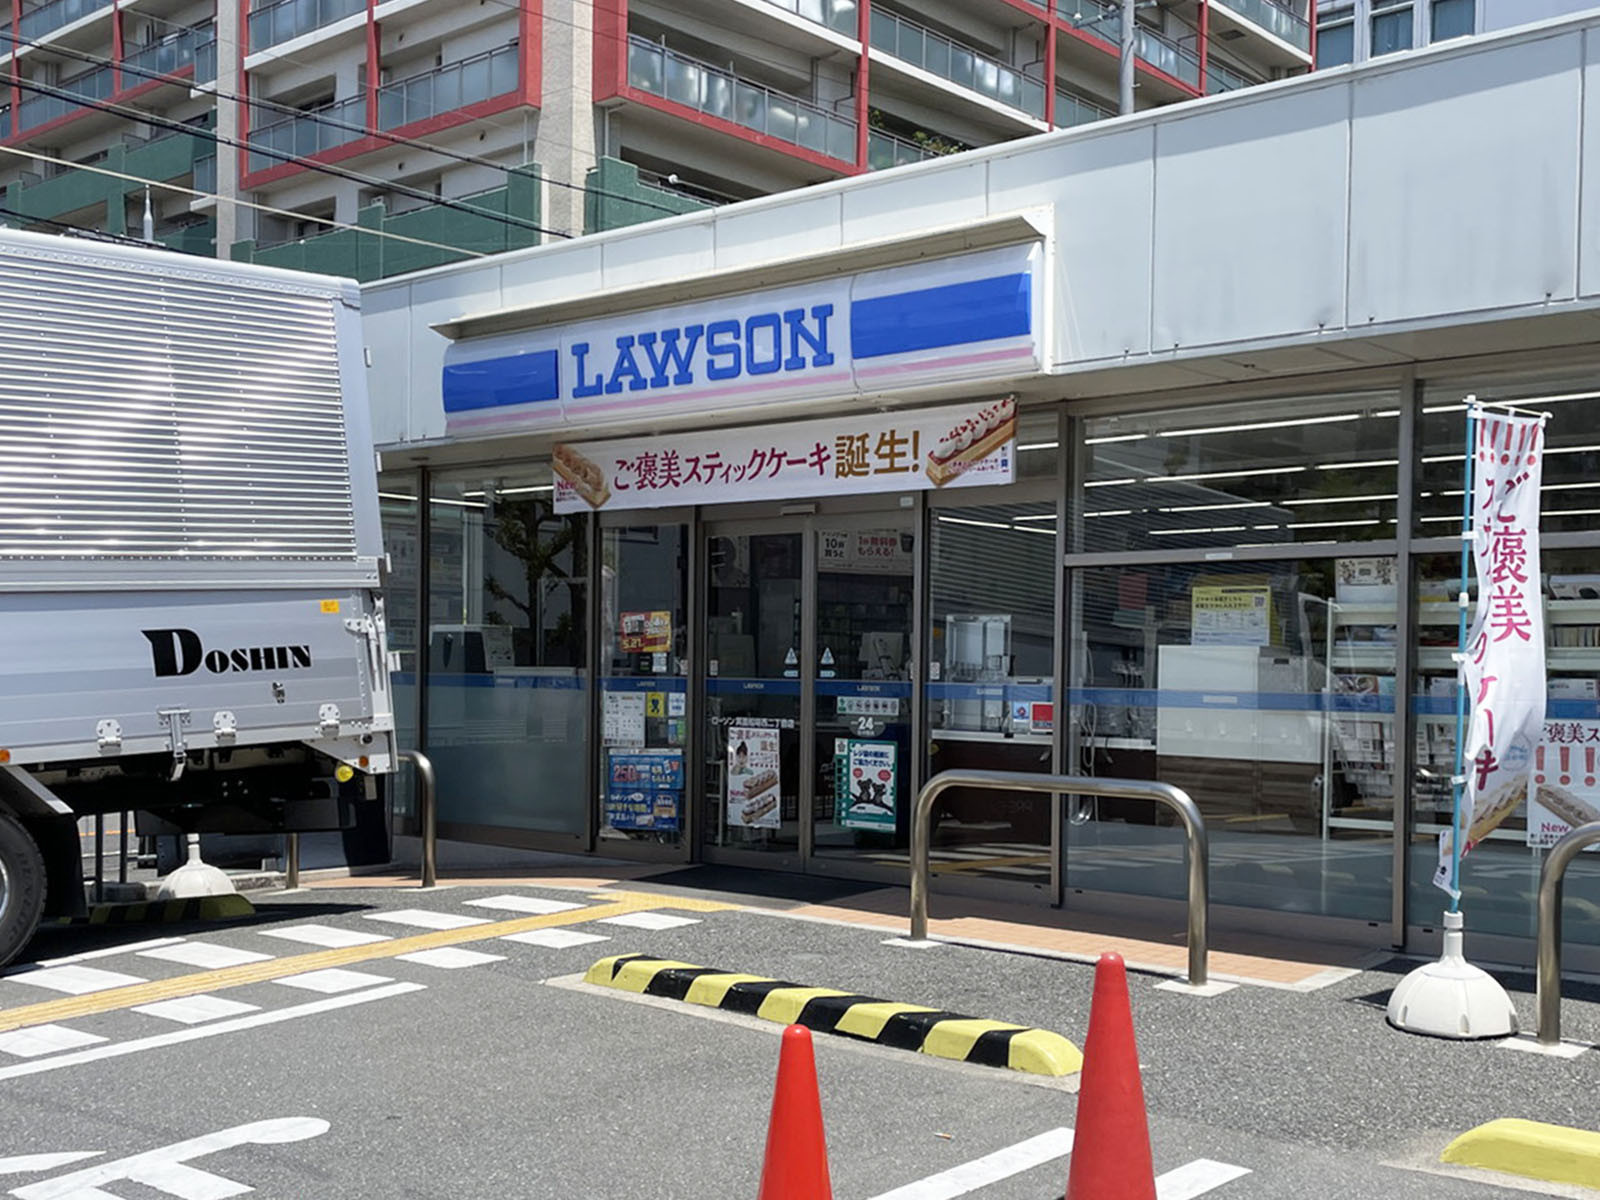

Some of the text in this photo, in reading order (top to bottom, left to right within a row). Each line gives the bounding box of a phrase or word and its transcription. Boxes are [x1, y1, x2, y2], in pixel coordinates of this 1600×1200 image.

[571, 303, 835, 399] LAWSON
[1491, 472, 1532, 642] ご褒美
[141, 627, 313, 678] DOSHIN
[857, 716, 874, 730] 24
[1539, 722, 1600, 744] 褒美ス
[1541, 822, 1570, 834] New
